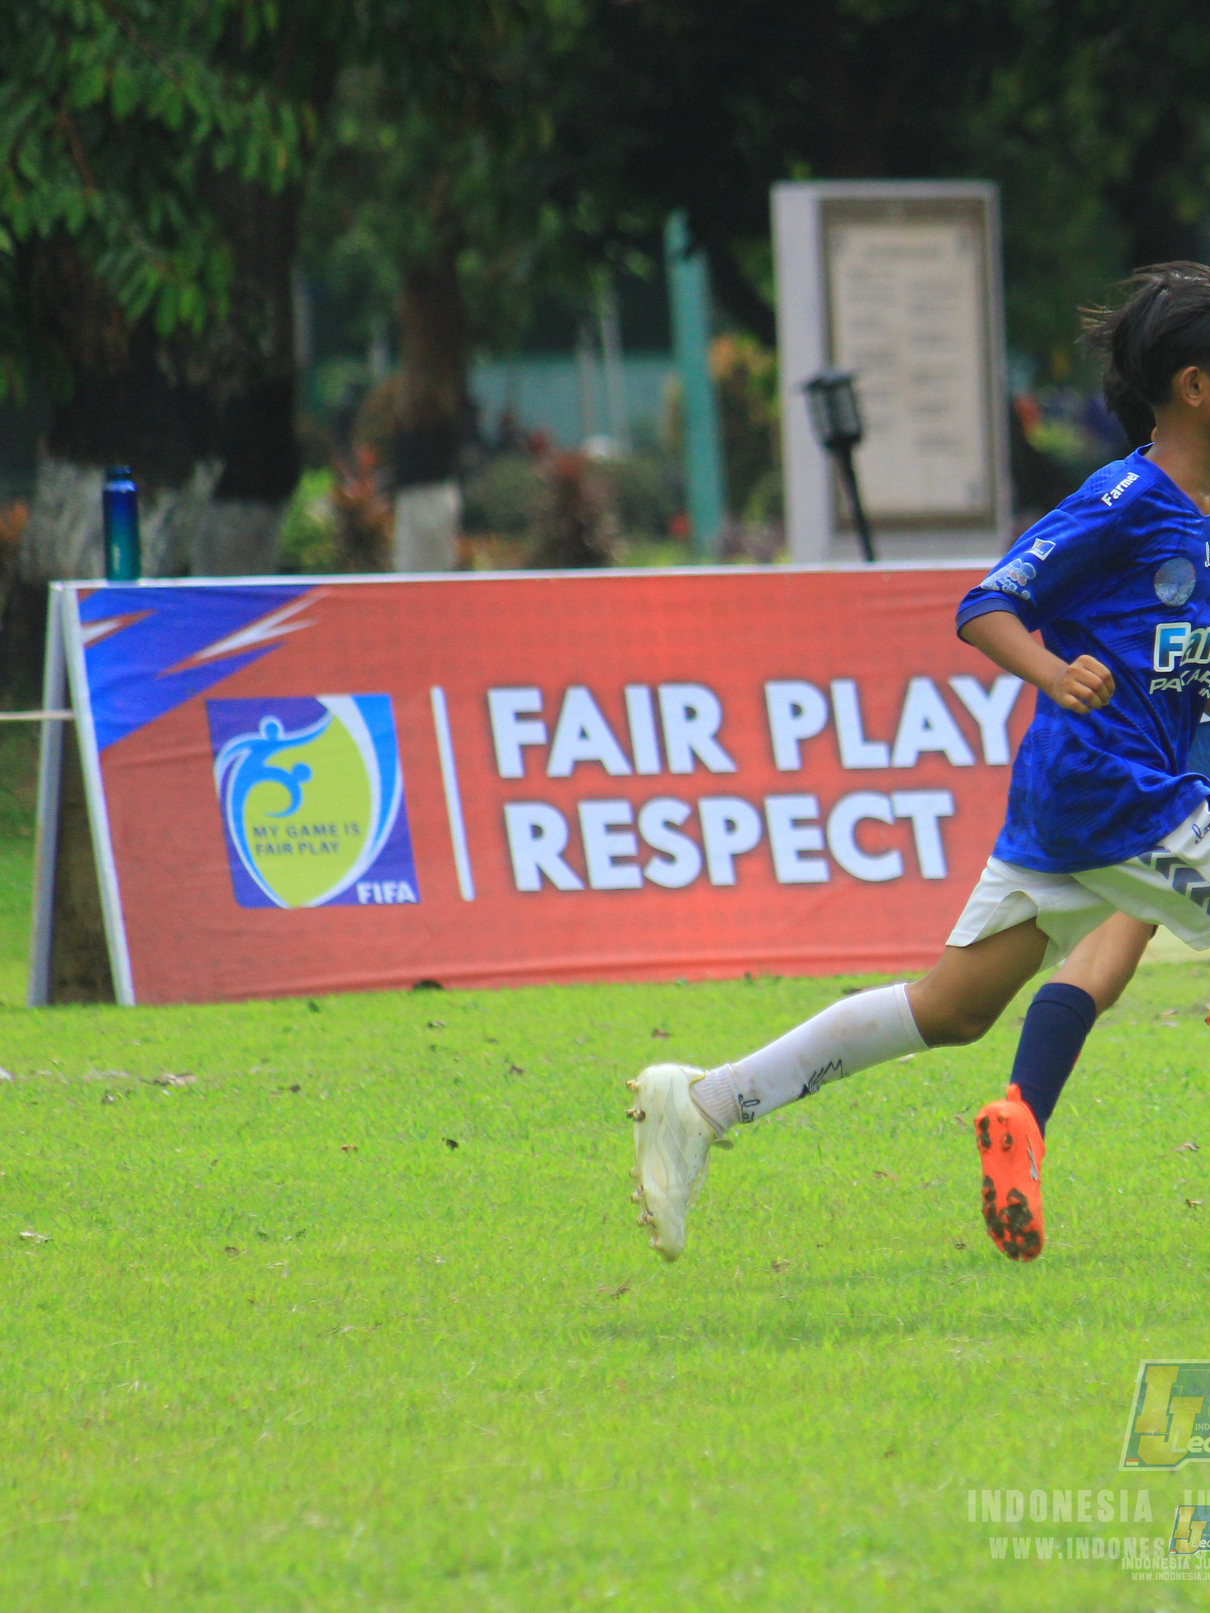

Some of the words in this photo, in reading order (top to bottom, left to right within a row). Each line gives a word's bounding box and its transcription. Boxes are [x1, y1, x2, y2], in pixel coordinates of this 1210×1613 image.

[1101, 472, 1139, 507] Farmel
[487, 683, 738, 778] FAIR
[764, 675, 1025, 772] PLAY
[253, 825, 278, 837] MY
[286, 824, 339, 837] GAME
[344, 823, 361, 837] IS
[504, 790, 954, 891] RESPECT
[255, 843, 295, 856] FAIR
[298, 841, 339, 855] PLAY
[356, 881, 418, 904] FIFA
